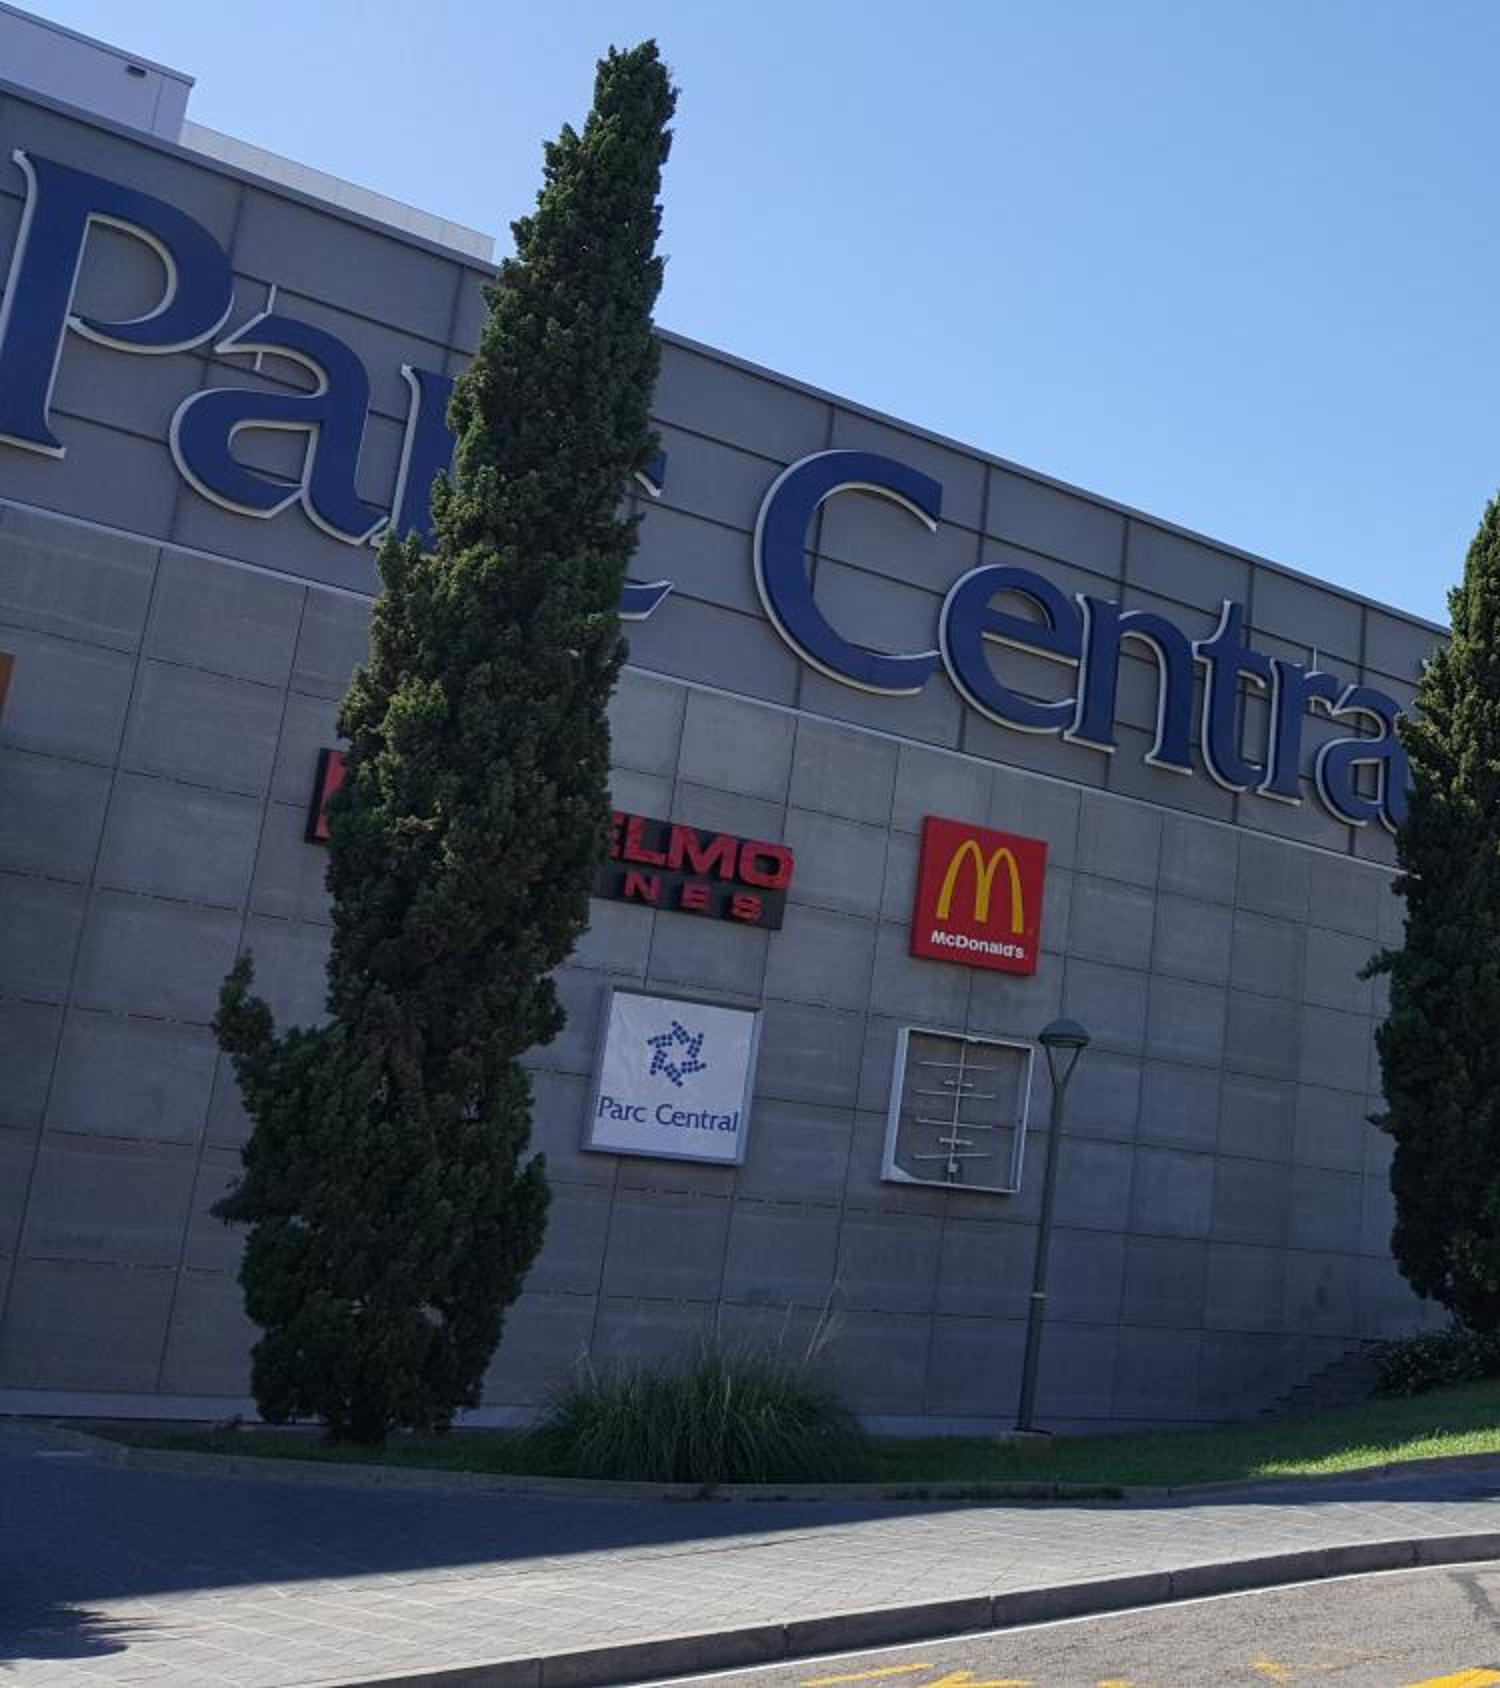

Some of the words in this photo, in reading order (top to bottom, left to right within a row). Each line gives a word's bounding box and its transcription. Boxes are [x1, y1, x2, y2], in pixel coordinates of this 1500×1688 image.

[0, 149, 674, 621] Pa
[753, 448, 1428, 837] Centra
[931, 930, 1025, 960] McDonald's
[598, 1095, 648, 1123] Parc
[655, 1103, 739, 1133] Central
